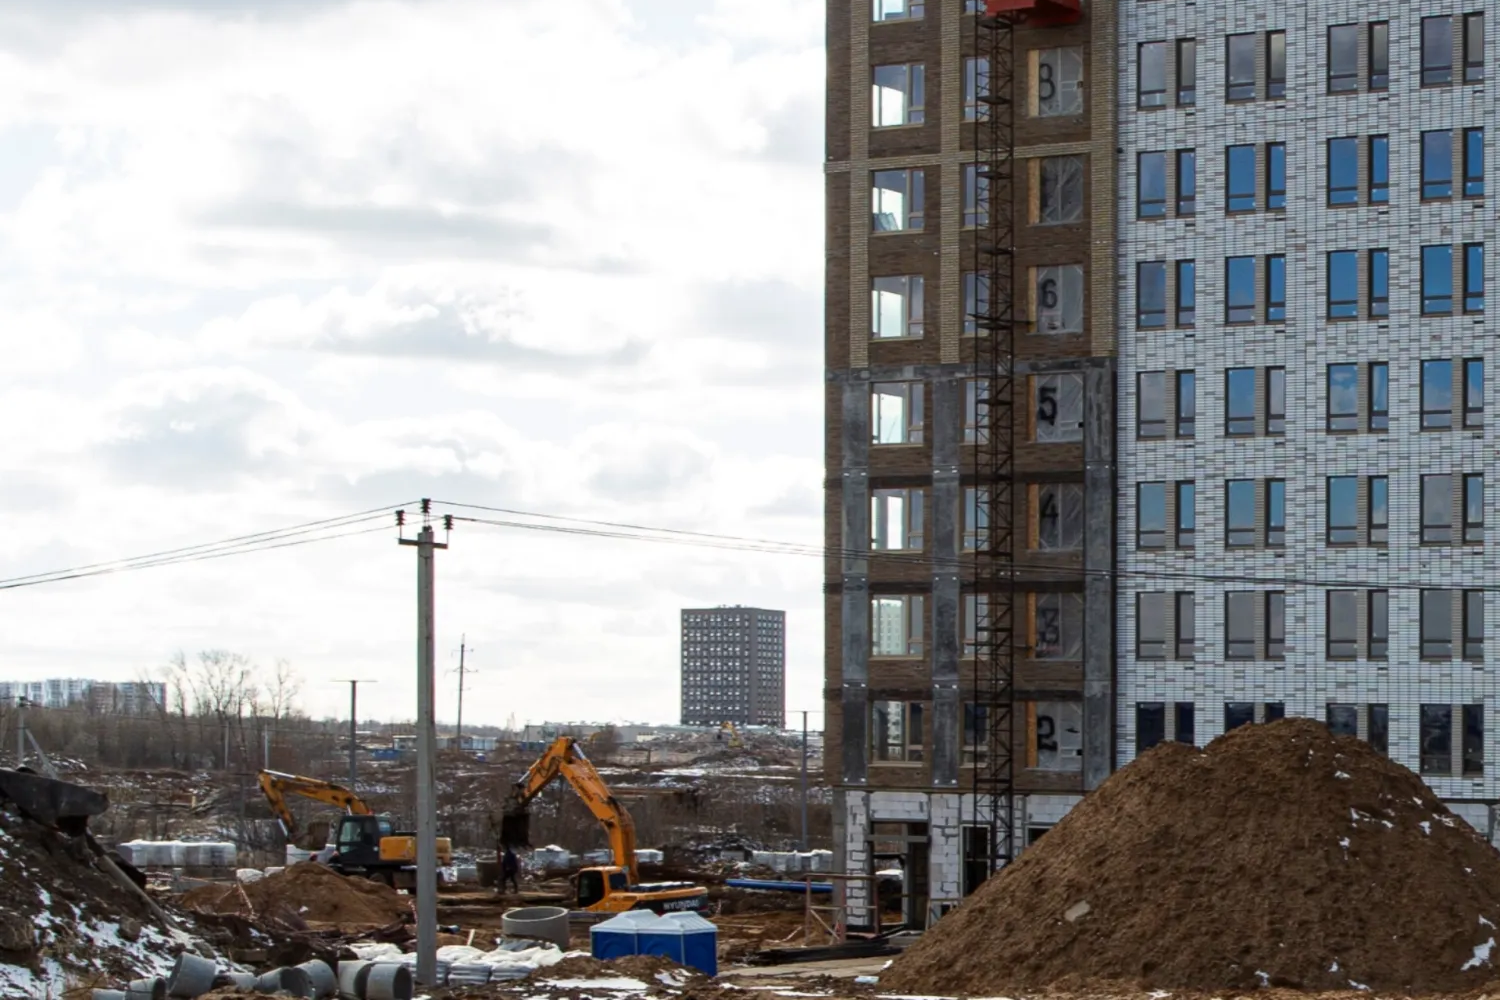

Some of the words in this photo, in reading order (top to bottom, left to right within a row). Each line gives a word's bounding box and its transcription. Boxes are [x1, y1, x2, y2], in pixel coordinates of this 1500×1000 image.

[1039, 63, 1055, 101] 8
[1039, 278, 1057, 309] 6
[1037, 387, 1057, 425] 5
[1040, 494, 1057, 527] 4
[1037, 715, 1056, 751] 2
